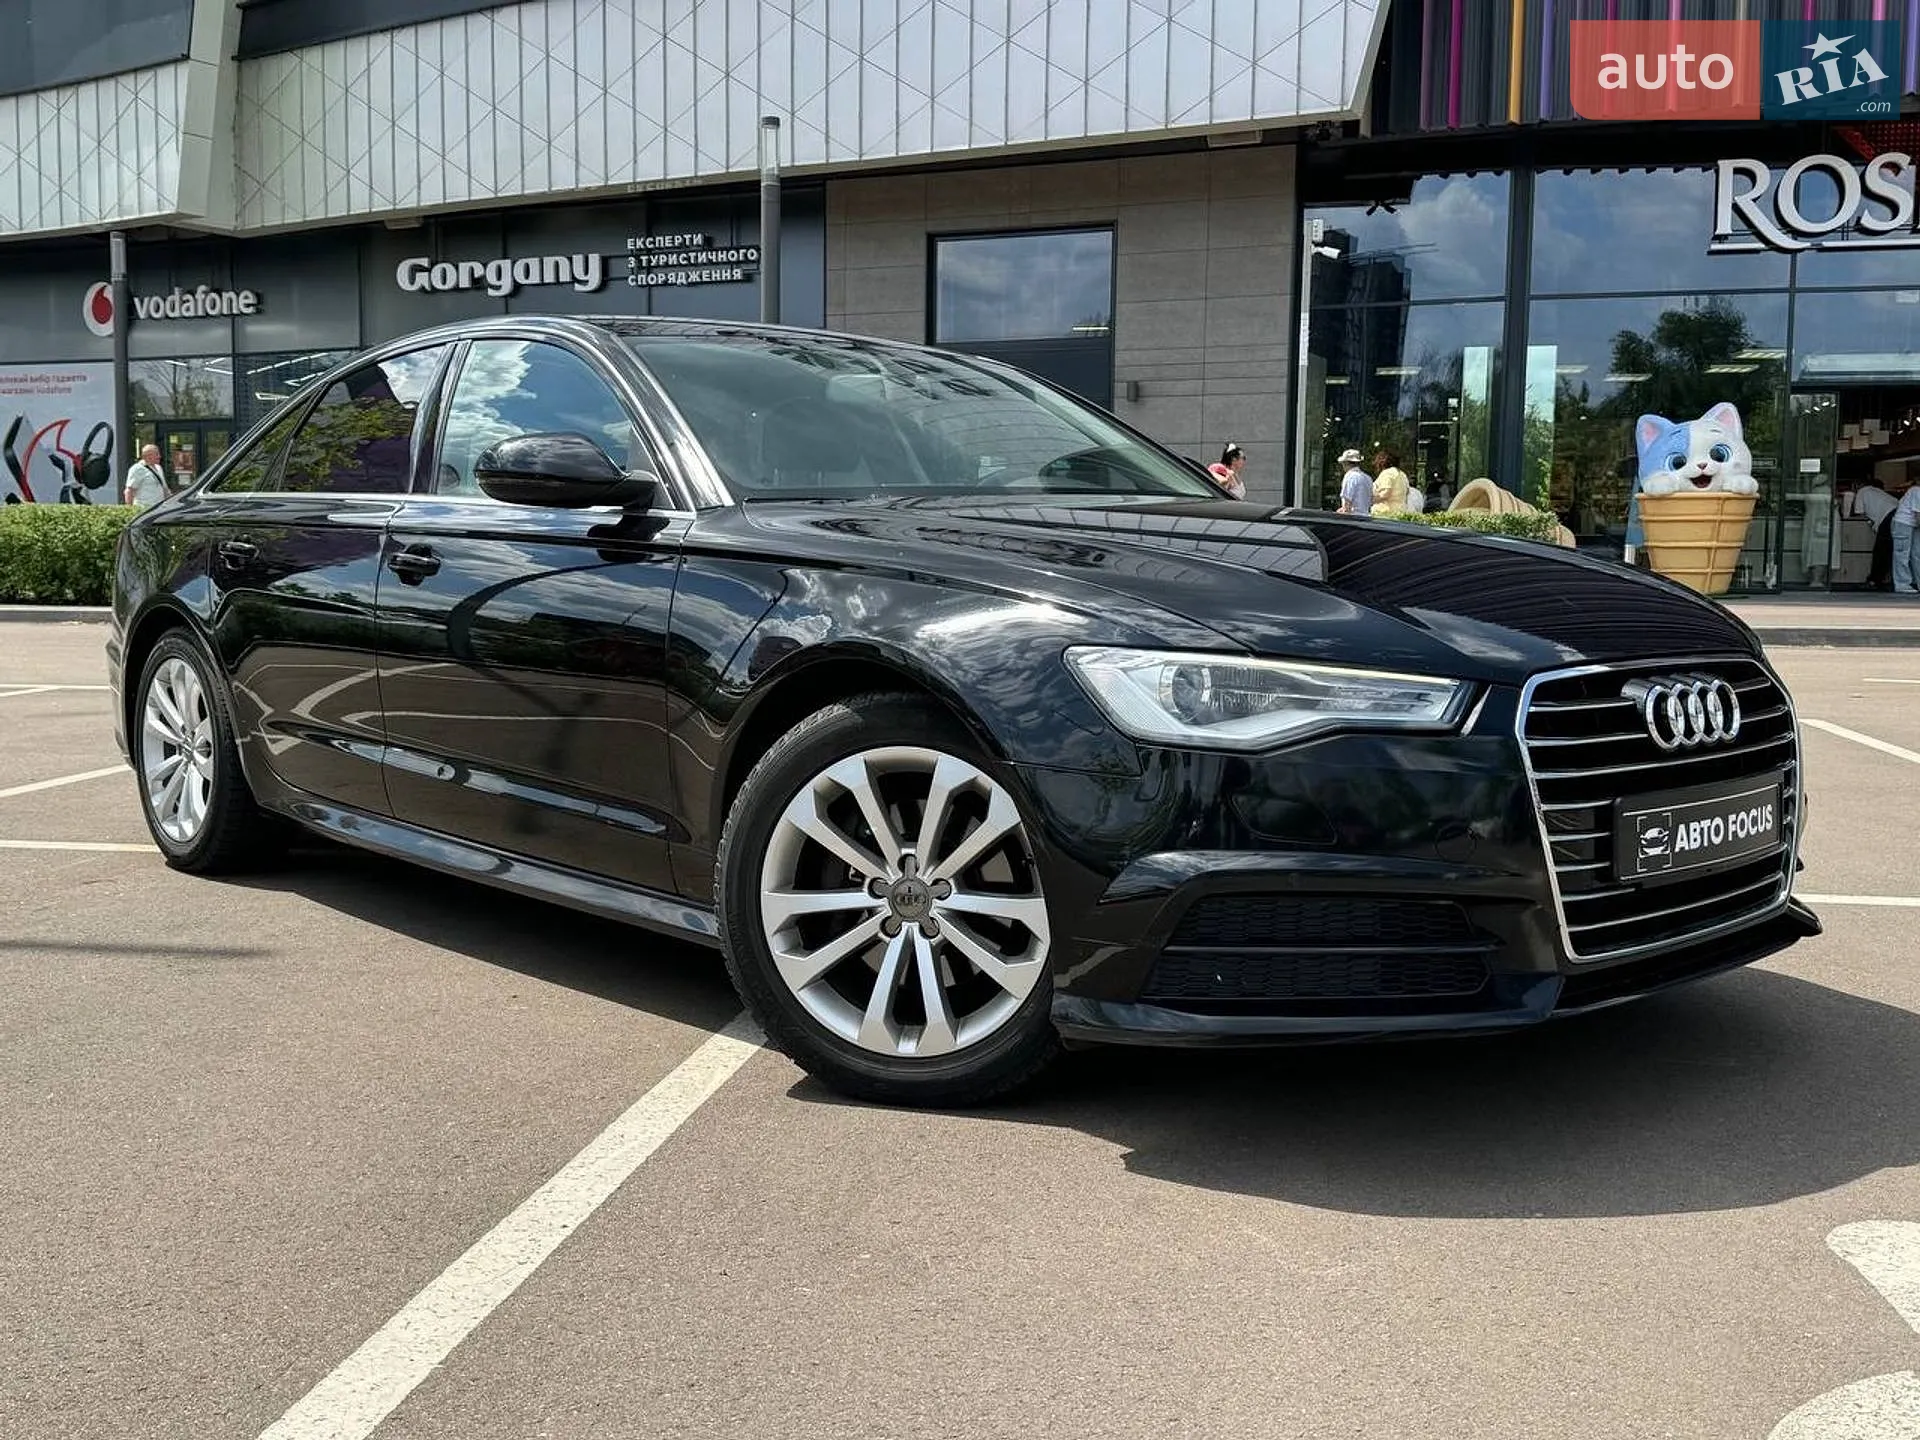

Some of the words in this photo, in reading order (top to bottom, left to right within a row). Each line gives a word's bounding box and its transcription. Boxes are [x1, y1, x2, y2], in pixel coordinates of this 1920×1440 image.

[1714, 152, 1920, 249] ROS
[627, 233, 703, 250] ЕКСПЕРТИ
[640, 248, 759, 267] ТУРИСТИЧНОГО
[396, 253, 601, 297] Gorgany
[628, 268, 743, 286] СПОРЯДЖЕННЯ
[133, 285, 258, 320] vodafone
[1674, 816, 1725, 853] АВТО
[1727, 803, 1774, 841] FOCUS
